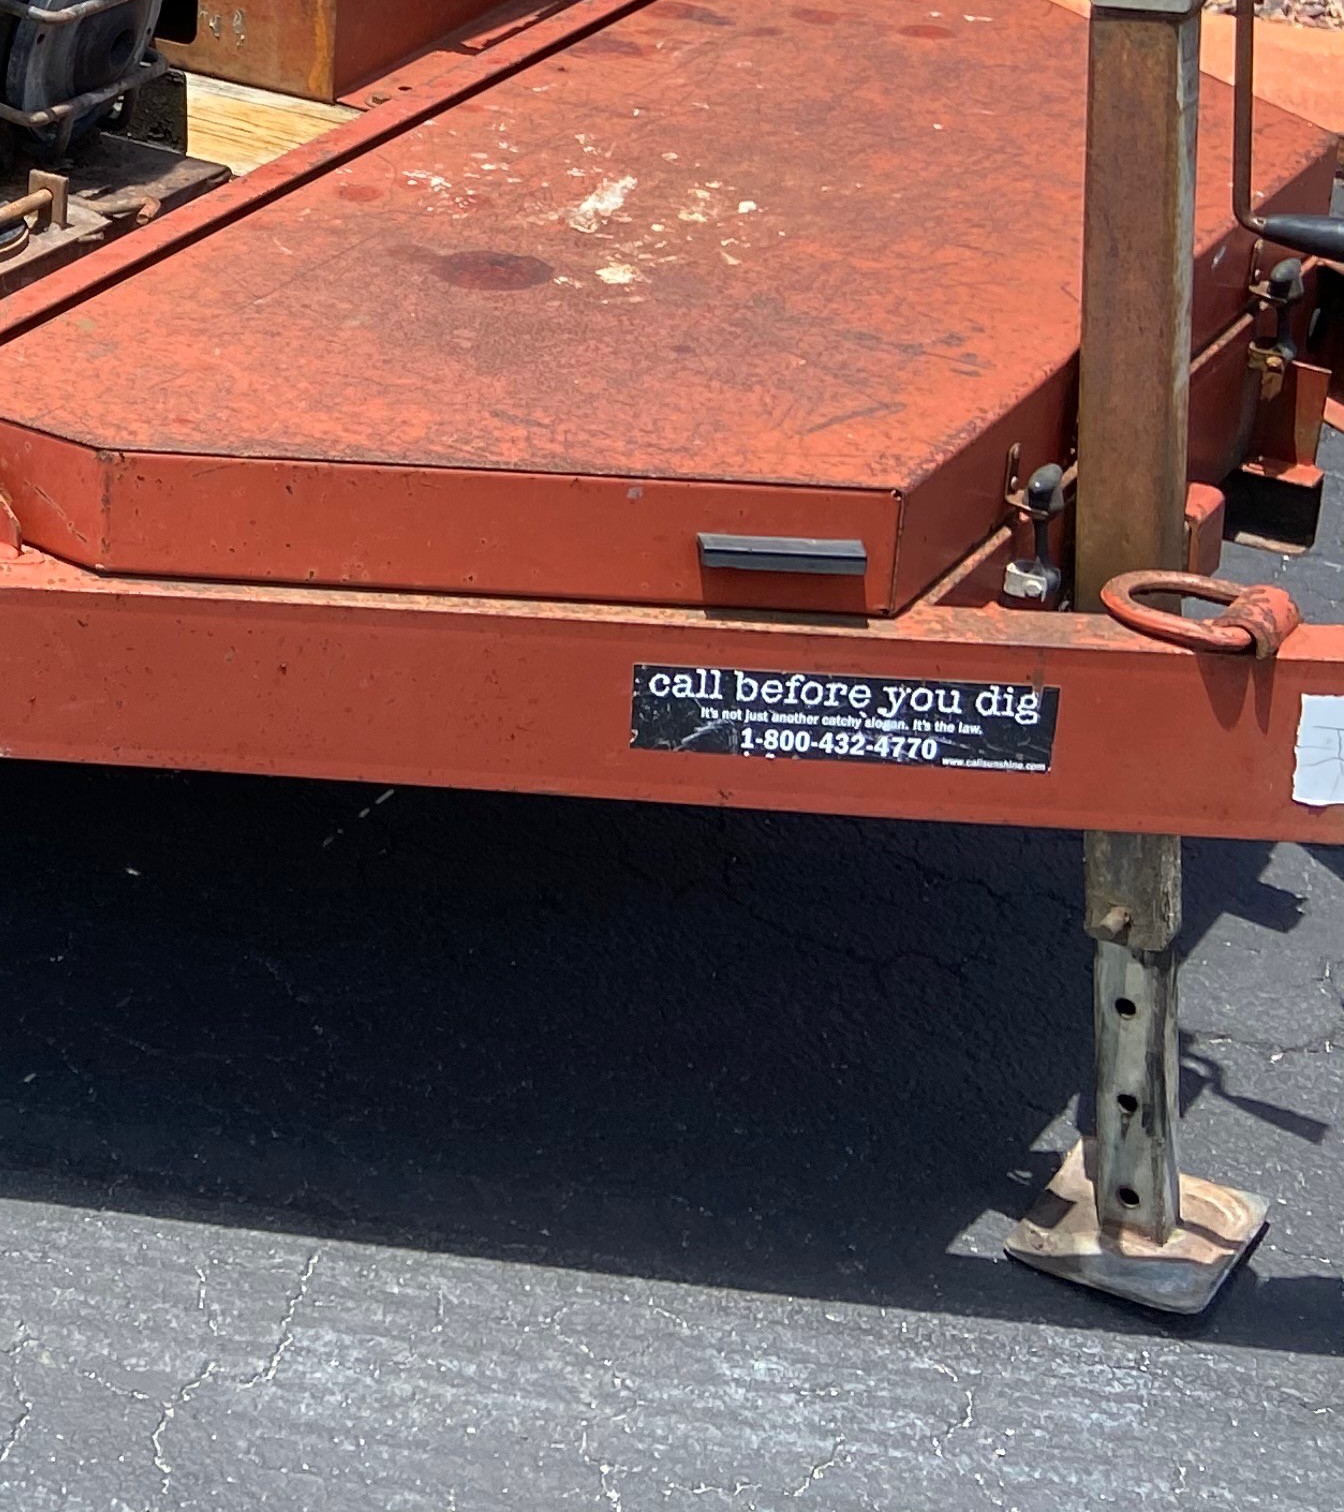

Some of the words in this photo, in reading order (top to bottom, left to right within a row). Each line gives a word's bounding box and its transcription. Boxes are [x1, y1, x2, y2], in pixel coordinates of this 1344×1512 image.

[648, 668, 723, 701] call
[734, 669, 872, 710] before
[877, 684, 963, 719] you
[975, 685, 1040, 726] dig
[700, 706, 720, 720] It's
[721, 708, 743, 722] not
[744, 708, 769, 724] just
[771, 711, 820, 726] another
[821, 714, 863, 731] catchy
[864, 716, 911, 734] slogan.
[912, 718, 932, 733] It's
[934, 719, 956, 734] the
[957, 721, 984, 736] law.
[740, 726, 938, 761] 1-800-432-4770
[941, 755, 1047, 774] www.callsunshine.com
